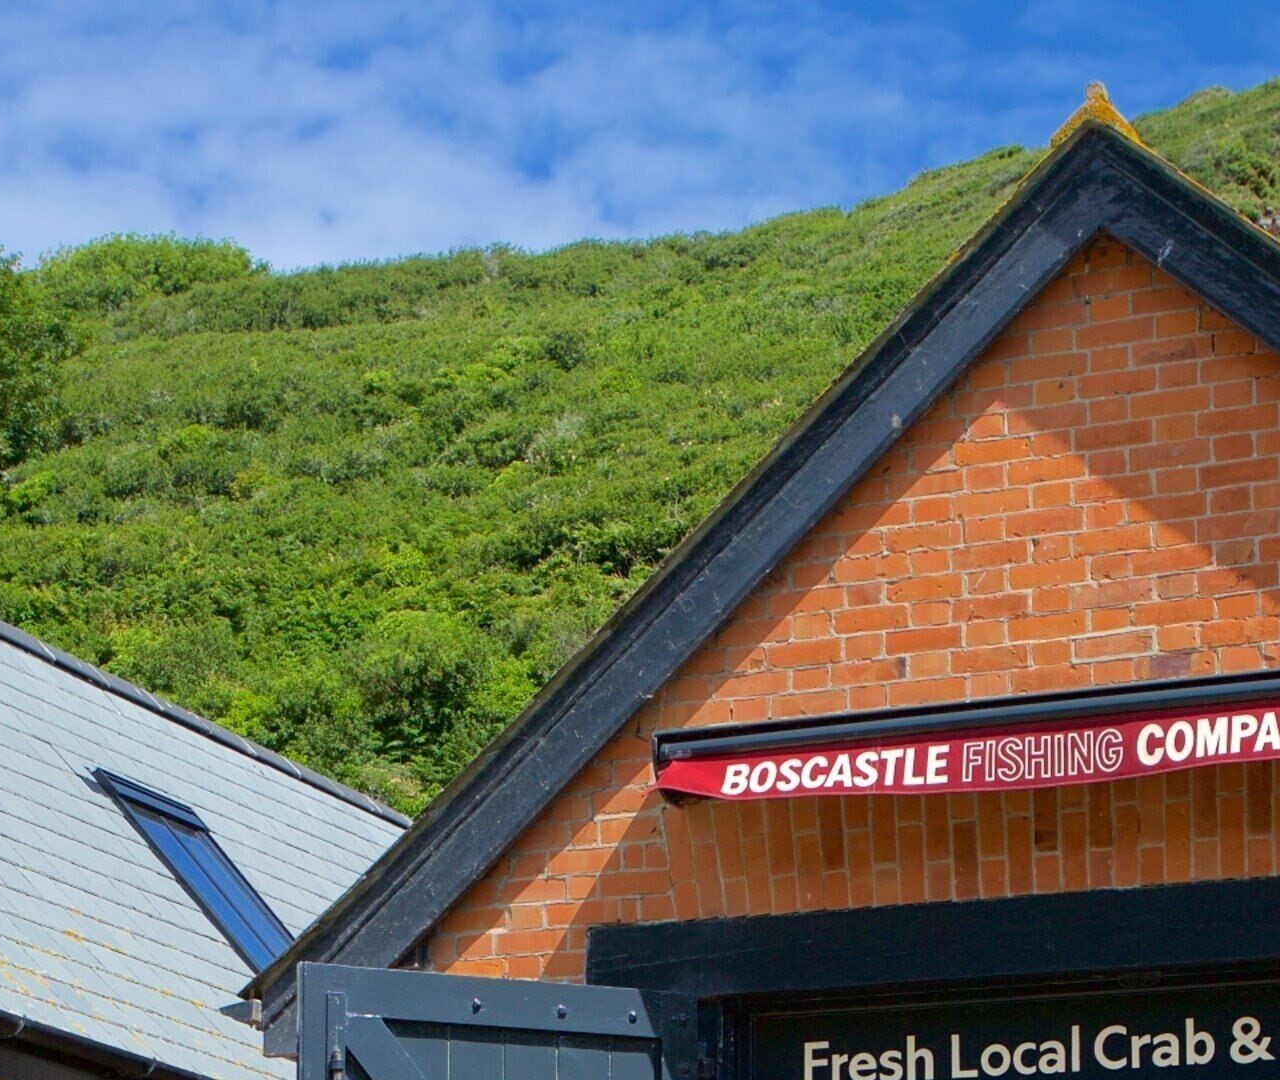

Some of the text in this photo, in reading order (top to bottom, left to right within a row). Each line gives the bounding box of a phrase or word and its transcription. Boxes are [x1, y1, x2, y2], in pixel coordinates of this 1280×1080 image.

[720, 744, 949, 796] BOSCASTLE
[960, 727, 1123, 783] FISHING
[951, 1024, 1081, 1079] Local
[1093, 1018, 1216, 1070] Crab
[1229, 1015, 1275, 1064] &
